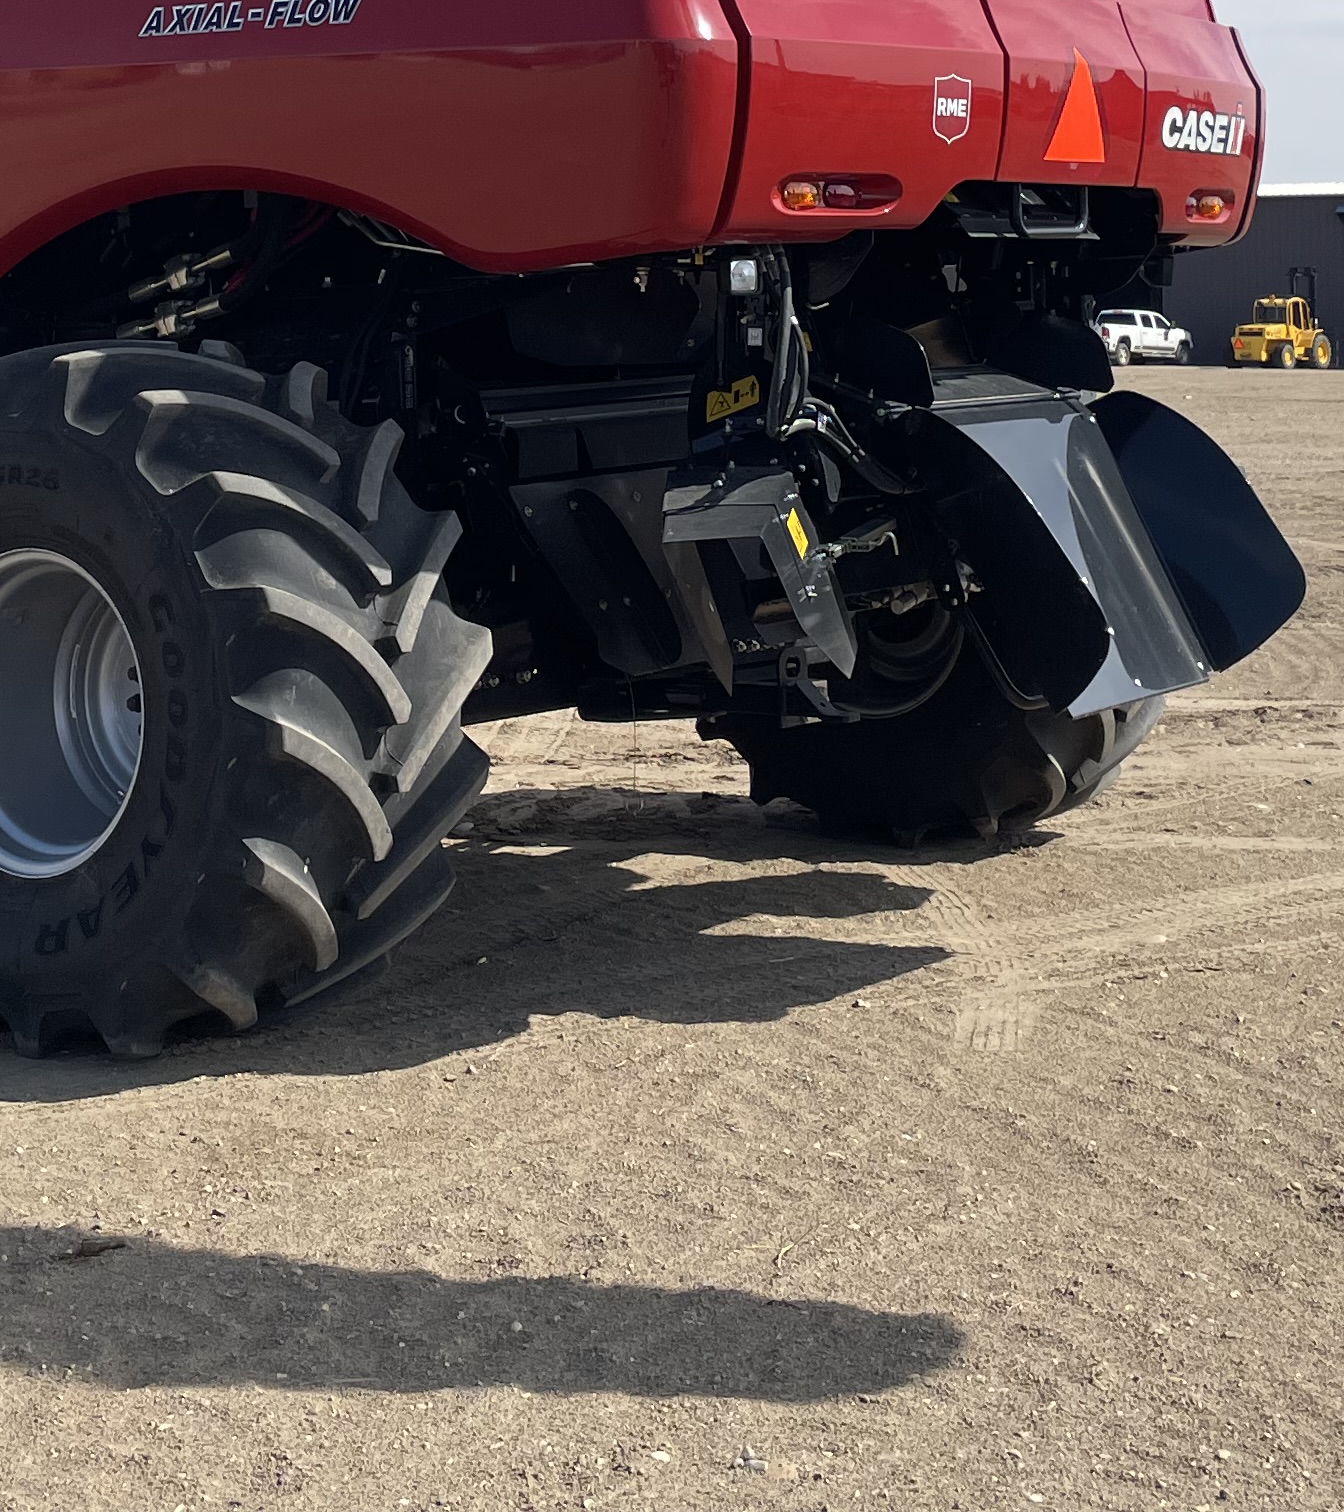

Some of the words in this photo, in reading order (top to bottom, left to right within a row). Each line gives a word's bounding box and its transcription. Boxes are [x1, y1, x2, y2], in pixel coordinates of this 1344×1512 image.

[936, 98, 967, 118] RME
[1162, 105, 1229, 153] CASE
[35, 592, 192, 957] GOODYEAR
